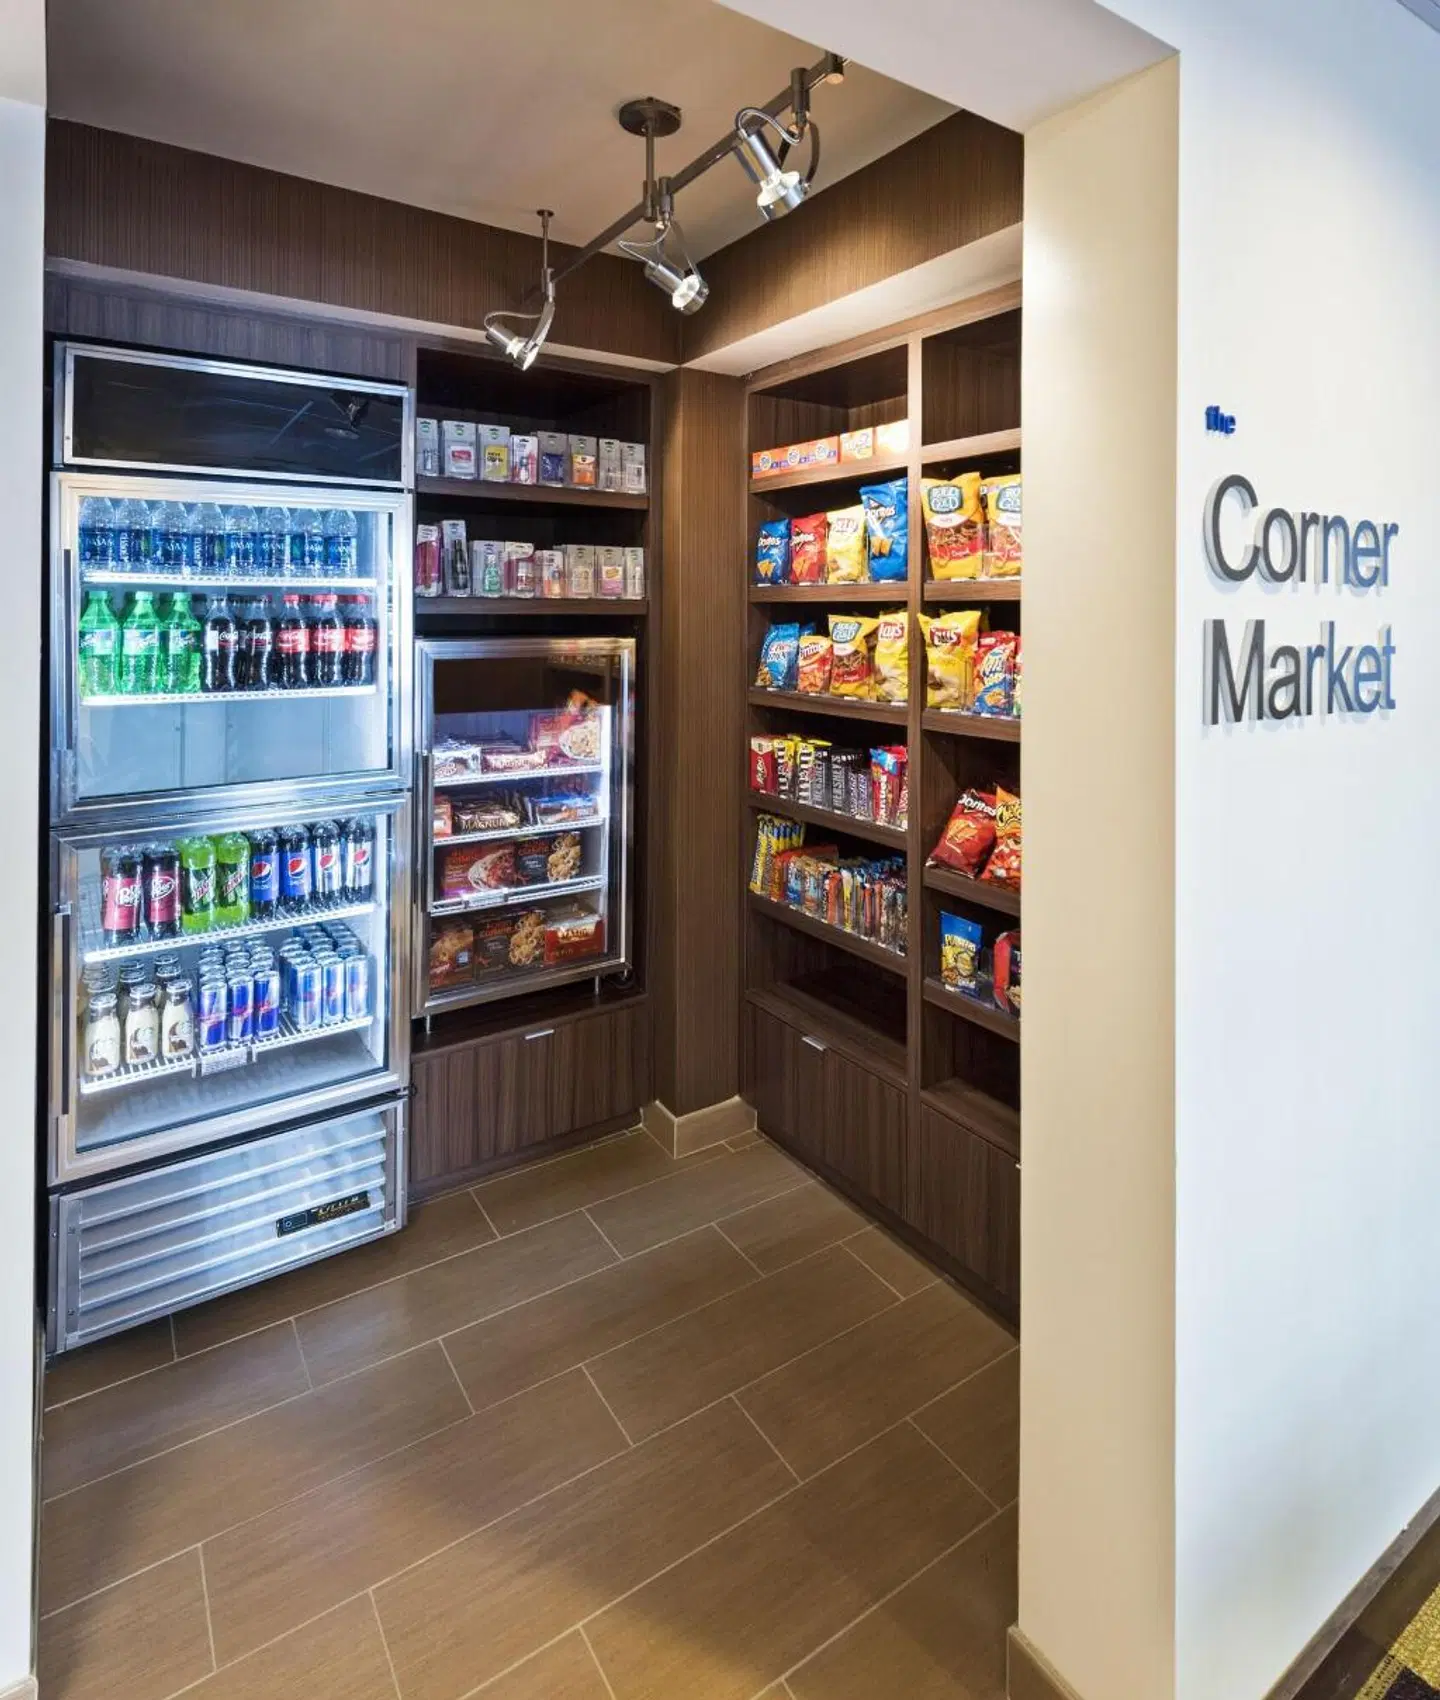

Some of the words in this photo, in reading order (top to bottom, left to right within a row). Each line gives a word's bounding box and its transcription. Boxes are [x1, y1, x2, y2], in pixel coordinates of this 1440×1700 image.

[1205, 405, 1237, 434] the
[1203, 474, 1400, 588] Corner
[1203, 618, 1397, 725] Market
[957, 793, 998, 817] Doritos
[461, 815, 510, 830] MAGNUM
